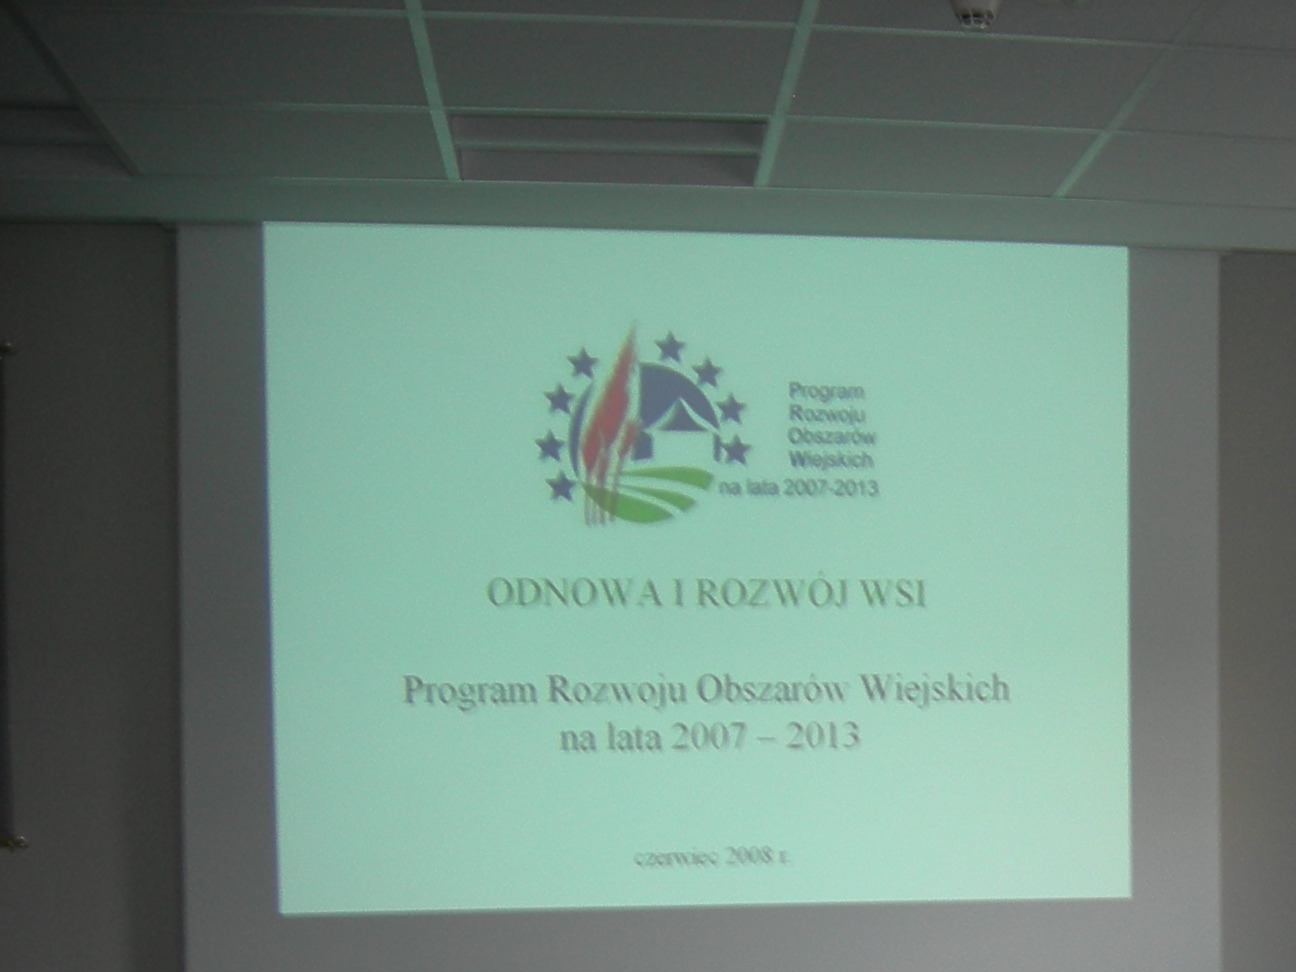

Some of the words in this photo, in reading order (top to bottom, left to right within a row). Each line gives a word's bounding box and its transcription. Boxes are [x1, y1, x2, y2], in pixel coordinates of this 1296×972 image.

[788, 382, 864, 403] Program
[789, 405, 866, 425] Rozwoju
[788, 427, 876, 446] Obszarów
[789, 450, 873, 469] Wiejskich
[719, 482, 741, 496] na
[747, 479, 780, 496] lata
[784, 479, 879, 497] 2007-2013
[487, 577, 662, 608] ODNOWA
[674, 578, 683, 607] I
[697, 571, 848, 608] ROZWÓJ
[861, 578, 926, 608] WSI
[403, 674, 537, 712] Program
[549, 674, 687, 711] Rozwoju
[697, 672, 847, 704] Obszarów
[861, 672, 1010, 709] Wiejskich
[560, 729, 596, 752] na
[607, 723, 663, 751] lata
[671, 721, 746, 750] 2007
[786, 721, 861, 750] 2013
[726, 845, 773, 866] 2008
